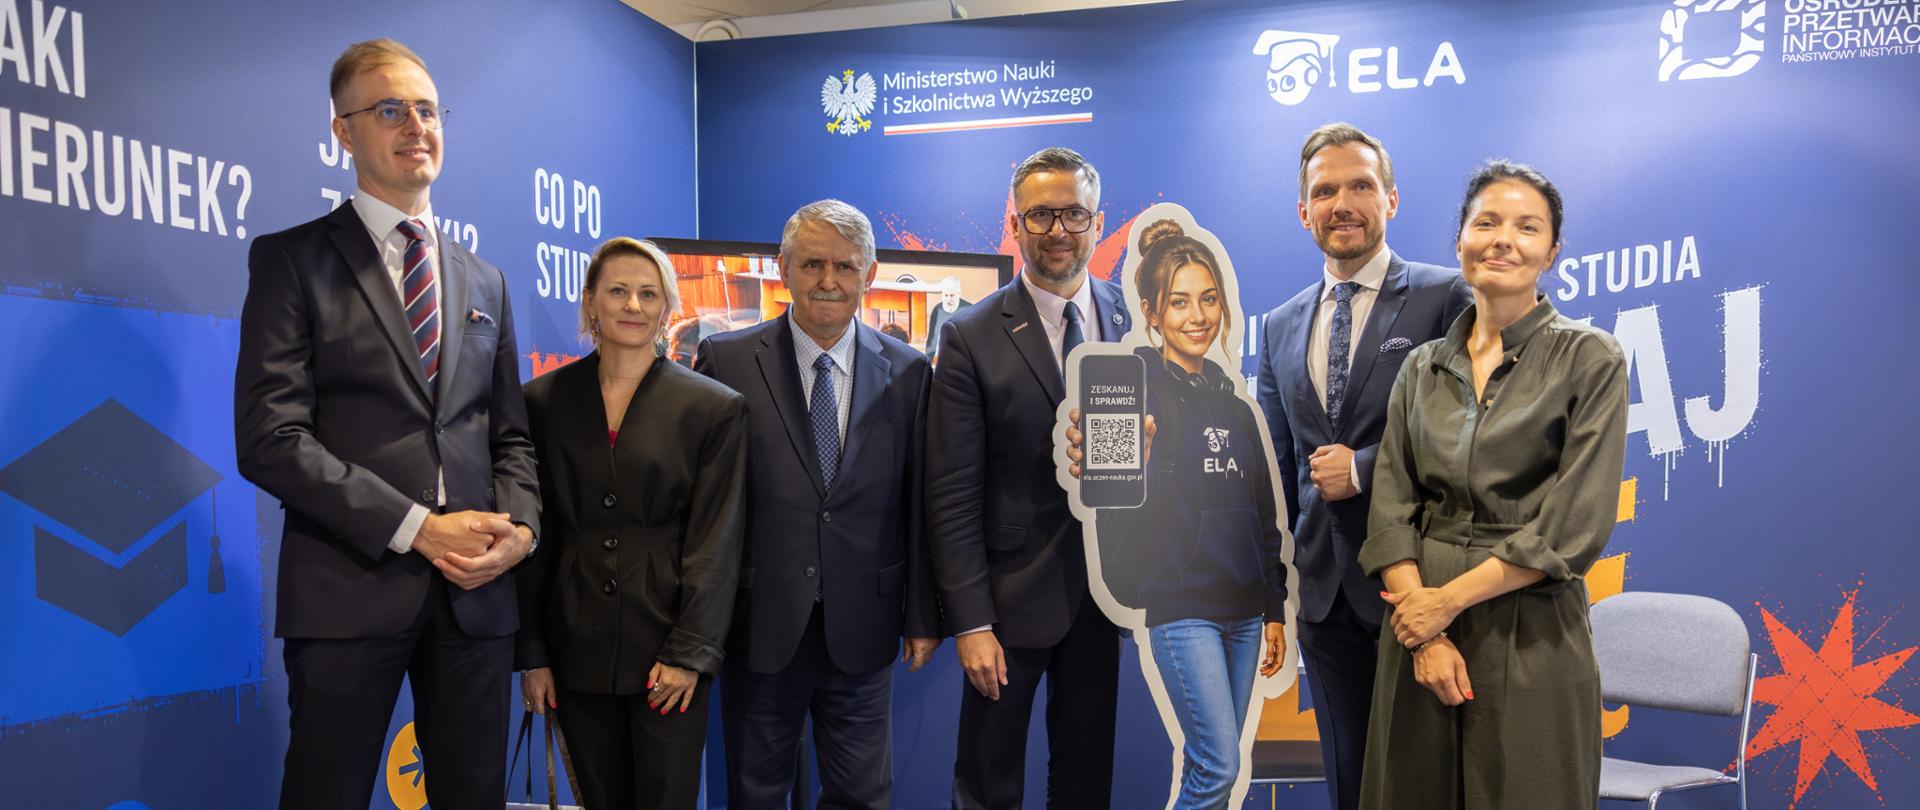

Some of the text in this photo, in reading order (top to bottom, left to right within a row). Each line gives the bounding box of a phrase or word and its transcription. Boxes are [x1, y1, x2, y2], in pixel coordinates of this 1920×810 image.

[1860, 45, 1916, 57] INSTYTUT
[884, 60, 1055, 90] Ministerstwo Nauki
[1348, 41, 1466, 93] ELA
[883, 86, 1093, 115] i Szkolnictwa Wyższego
[534, 168, 565, 229] CO
[574, 180, 601, 239] PO
[1556, 235, 1701, 302] STUDIA
[1090, 385, 1135, 394] ZESKANUJ
[1090, 395, 1136, 405] I SPRAWDŹ!
[1204, 457, 1238, 473] ELA
